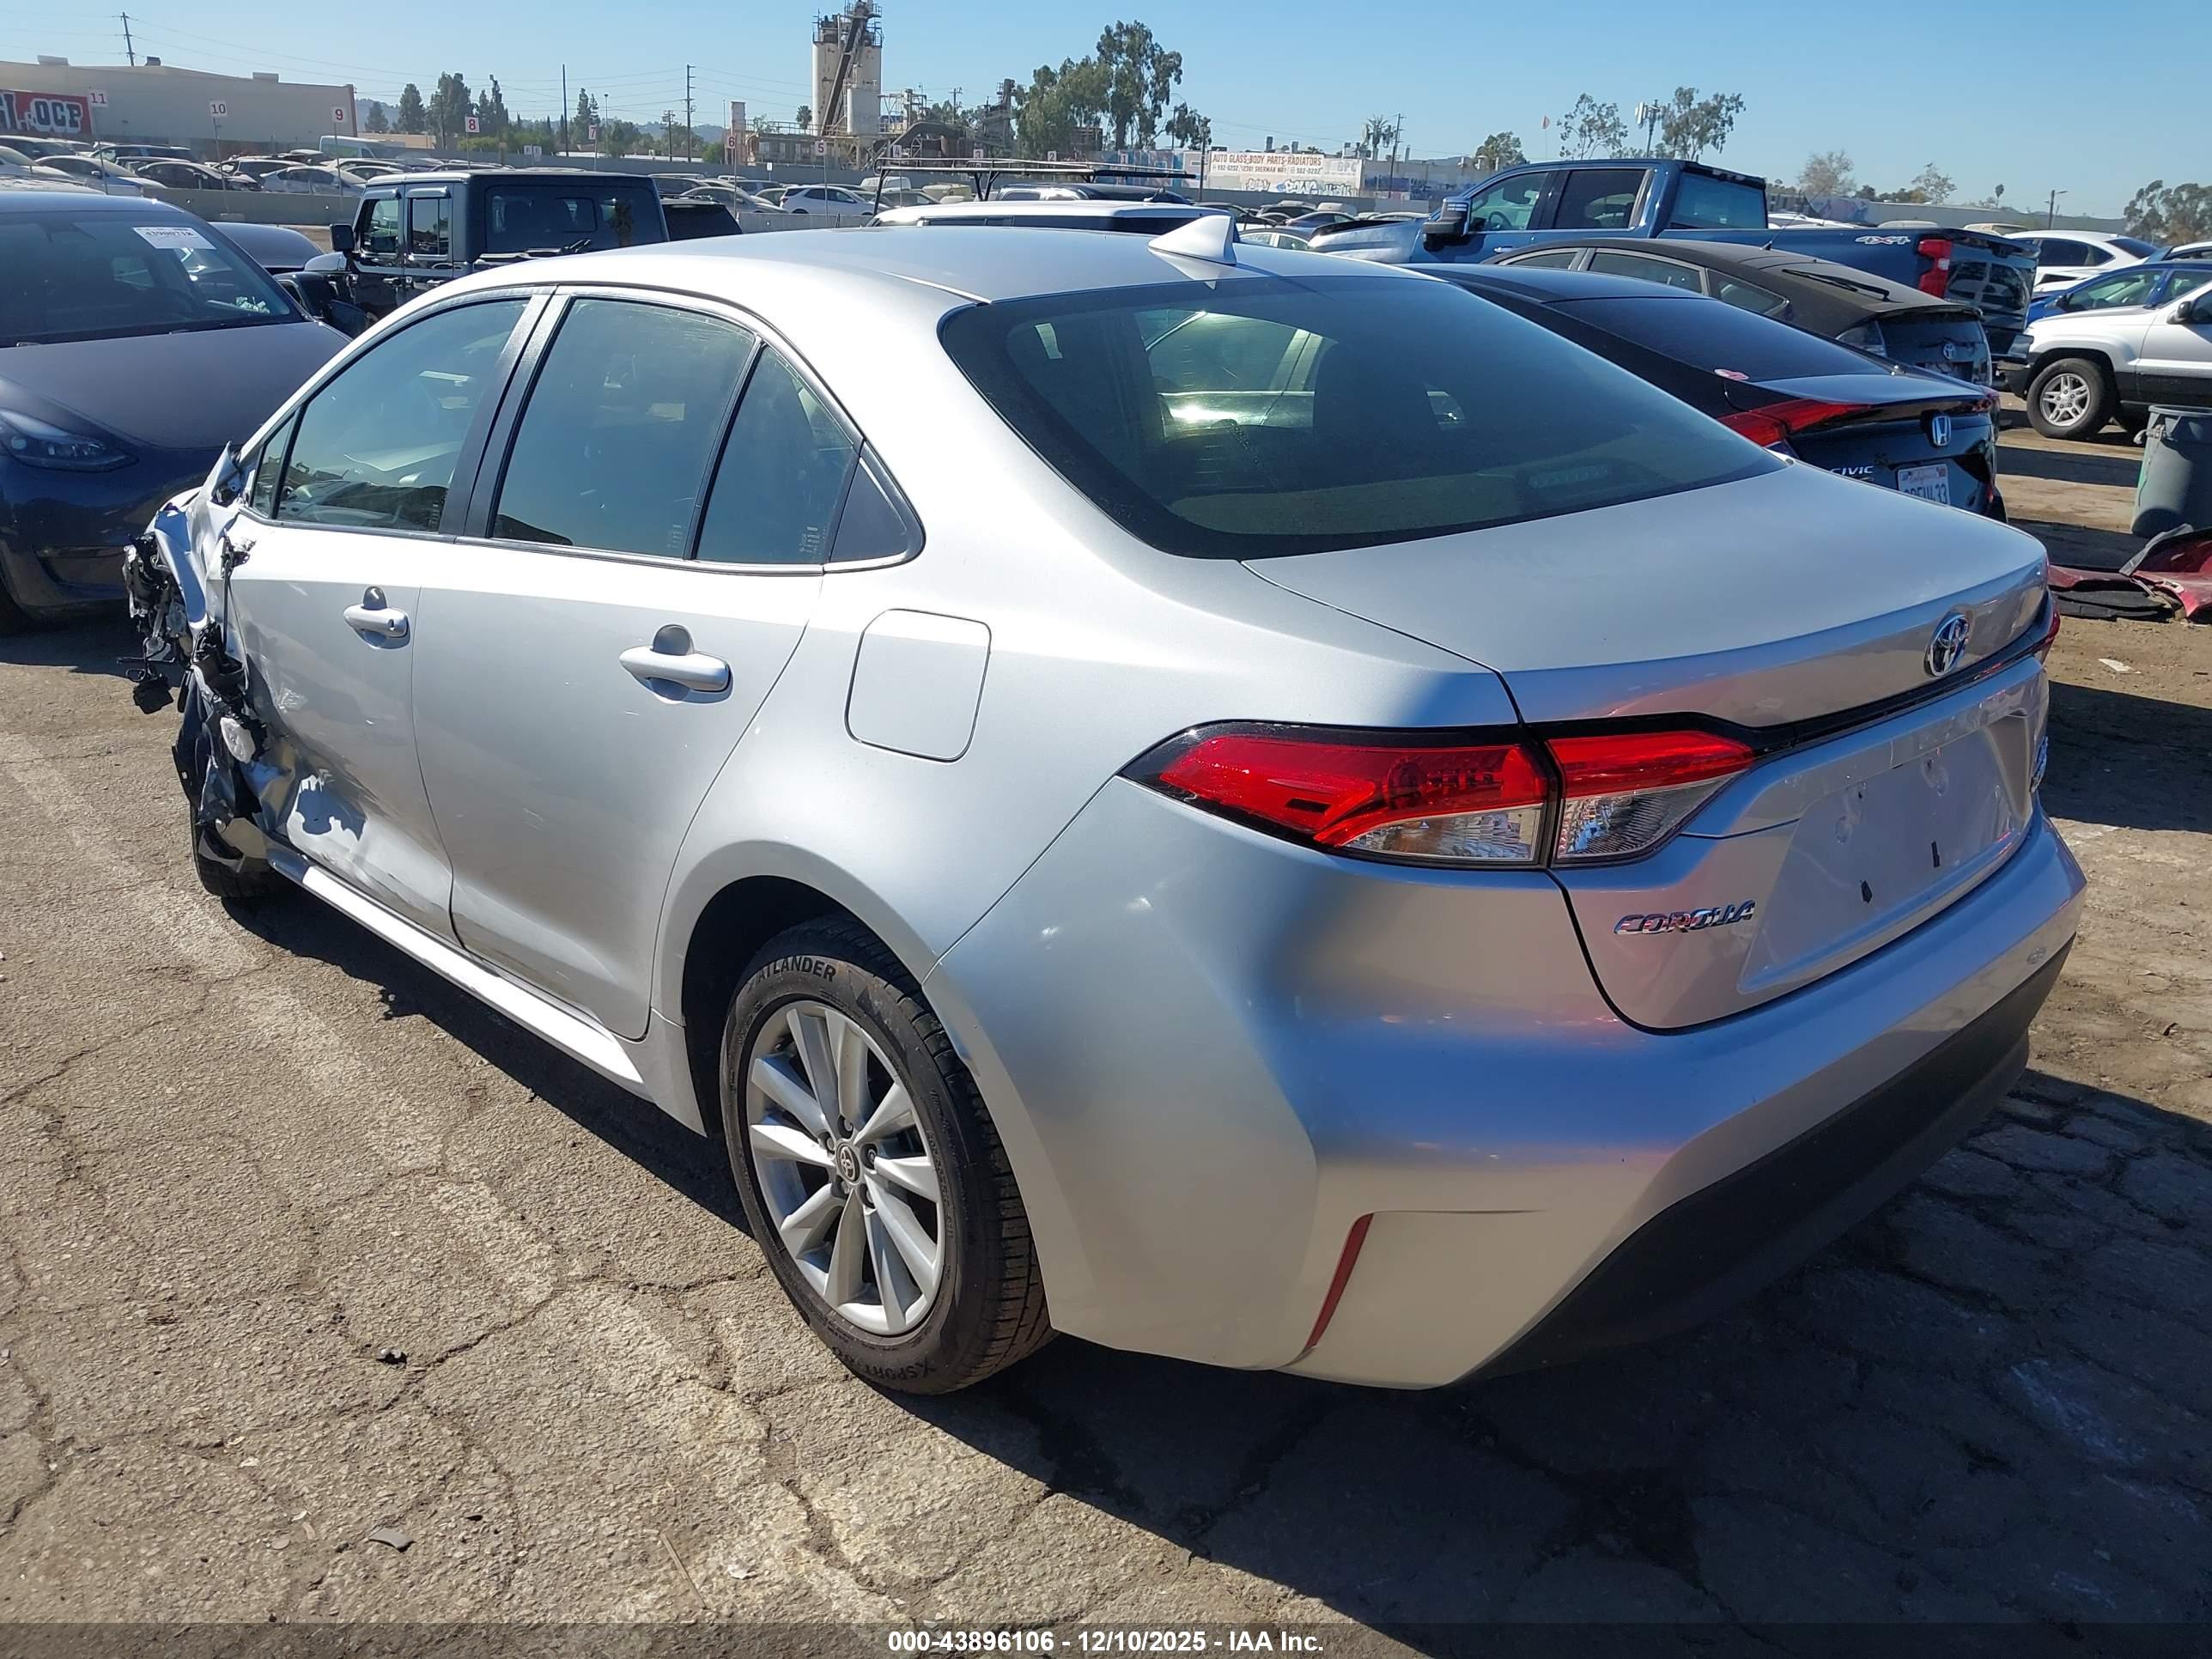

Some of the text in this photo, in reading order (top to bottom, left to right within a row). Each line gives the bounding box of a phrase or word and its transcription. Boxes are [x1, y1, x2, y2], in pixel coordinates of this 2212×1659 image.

[89, 92, 107, 104] 11
[211, 103, 227, 115] 10
[335, 108, 344, 121] 9
[468, 118, 477, 131] 8
[590, 127, 597, 138] 7
[728, 137, 735, 148] 6
[817, 143, 824, 154] 5
[894, 145, 901, 156] 4
[1049, 152, 1055, 161] 2
[1212, 154, 1228, 163] AUTO
[1830, 465, 1875, 477] CIVIC
[1613, 898, 1757, 936] COROLLA
[757, 955, 837, 983] ATLANDER
